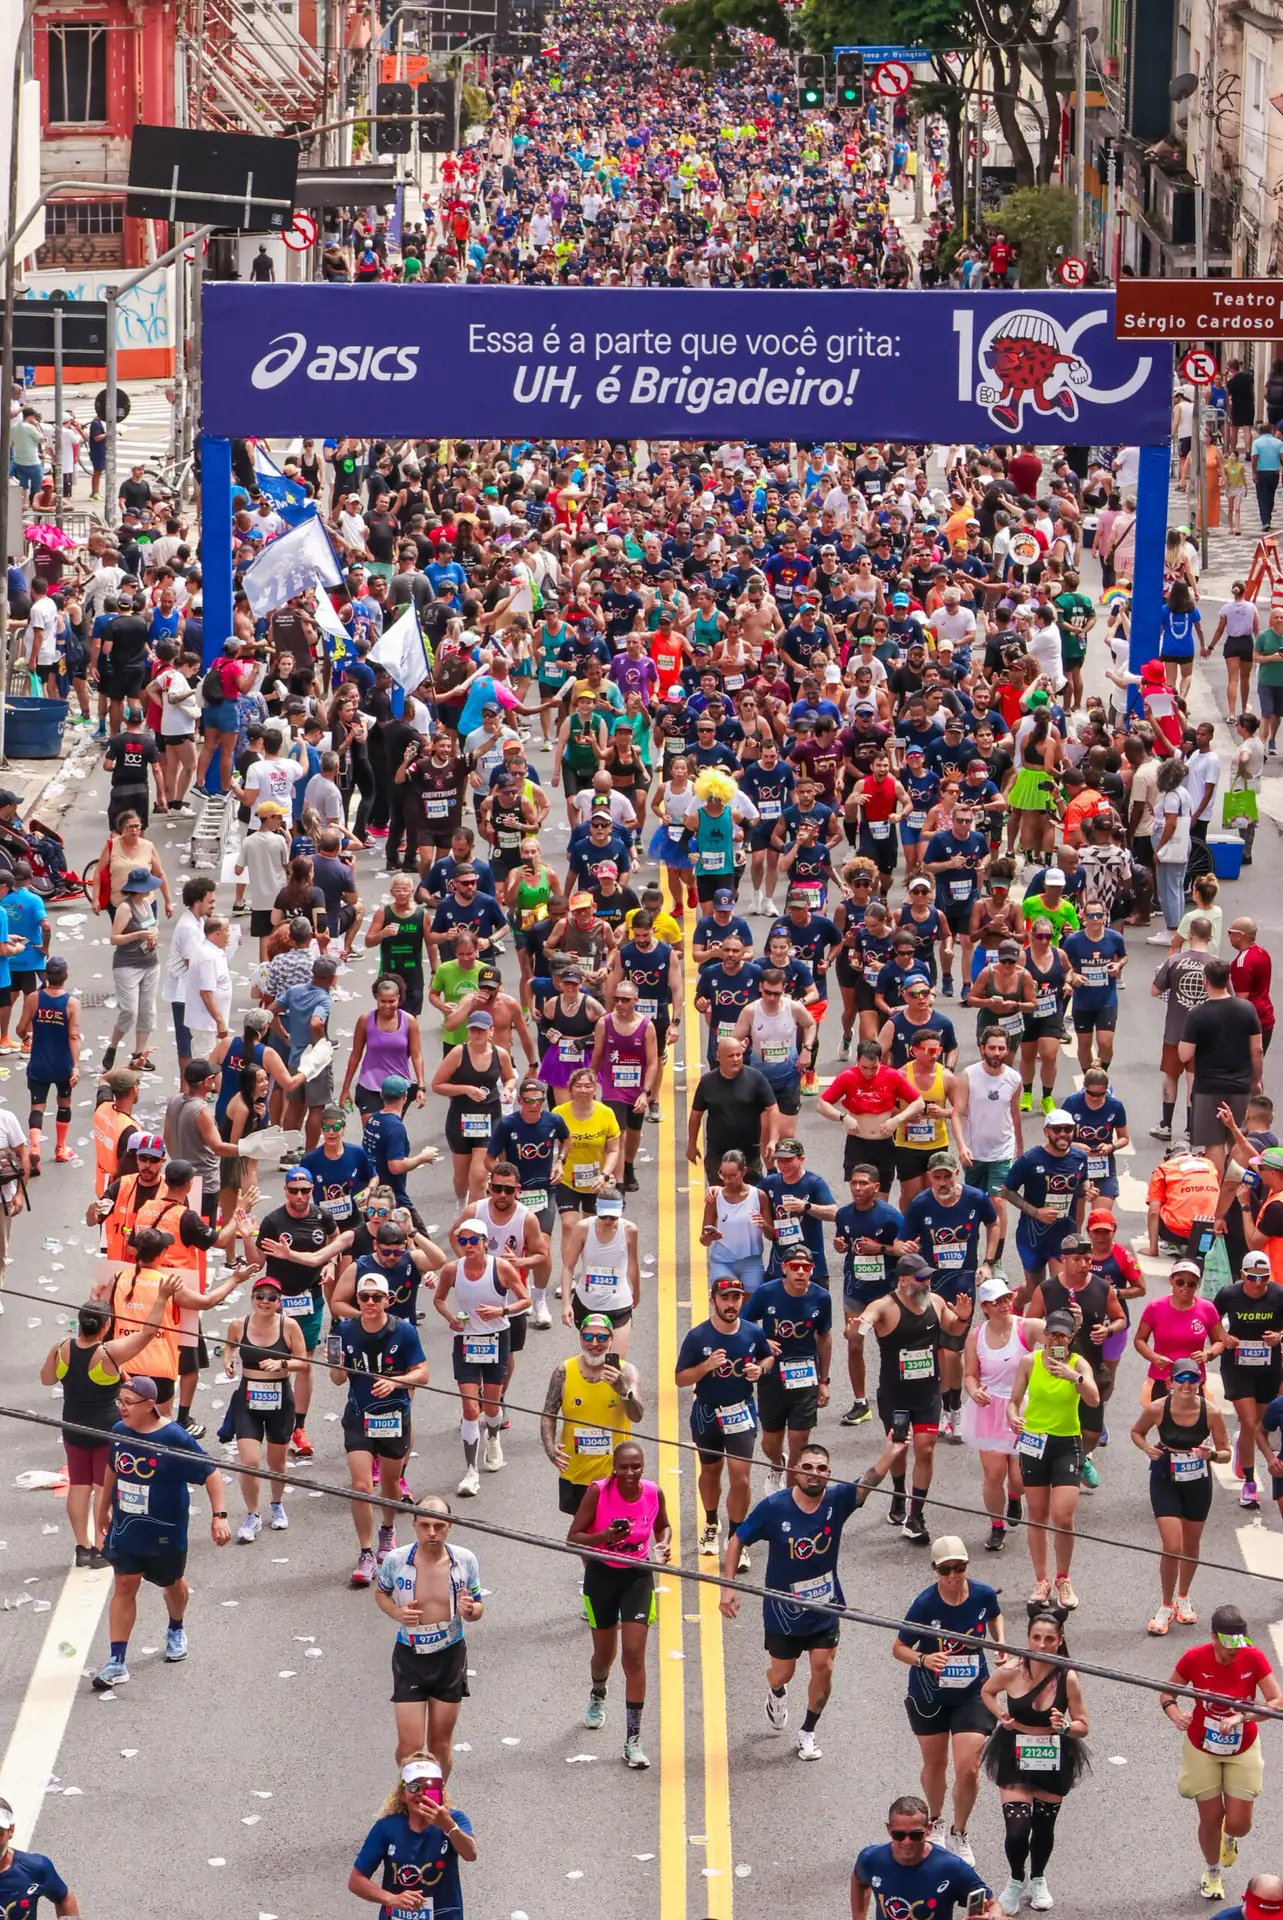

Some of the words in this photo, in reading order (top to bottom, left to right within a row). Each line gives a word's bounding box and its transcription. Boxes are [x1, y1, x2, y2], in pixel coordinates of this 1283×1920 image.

[892, 51, 927, 59] Byington
[1213, 292, 1275, 306] Teatro
[1124, 313, 1186, 332] Sérgio
[1196, 314, 1275, 329] Cardoso
[469, 323, 534, 354] Essa
[543, 323, 561, 354] é
[569, 332, 586, 354] a
[596, 329, 672, 360] parte
[681, 332, 738, 361] que
[746, 326, 818, 357] você
[827, 327, 901, 363] grita:
[512, 364, 583, 410] UH,
[596, 364, 623, 404] é
[630, 364, 861, 414] Brigadeiro!
[912, 1126, 929, 1134] 9767
[943, 1252, 964, 1261] 11176
[857, 1264, 880, 1273] 20673
[593, 1276, 614, 1285] 3342
[285, 1299, 307, 1307] 11667
[1235, 1312, 1274, 1322] VEGRUN
[472, 1345, 491, 1354] 5137
[1244, 1350, 1266, 1358] 14371
[907, 1359, 931, 1370] 33916
[790, 1369, 809, 1379] 9317
[253, 1391, 278, 1401] 13550
[373, 1418, 396, 1429] 11017
[726, 1413, 747, 1425] 2724
[582, 1437, 609, 1447] 13046
[1021, 1434, 1041, 1448] 2054
[1180, 1462, 1201, 1472] 5887
[124, 1493, 139, 1504] 967
[807, 1585, 829, 1601] 3867
[419, 1631, 439, 1645] 9771
[947, 1665, 973, 1676] 11123
[1025, 1747, 1055, 1758] 21246
[397, 1908, 427, 1920] 11824
